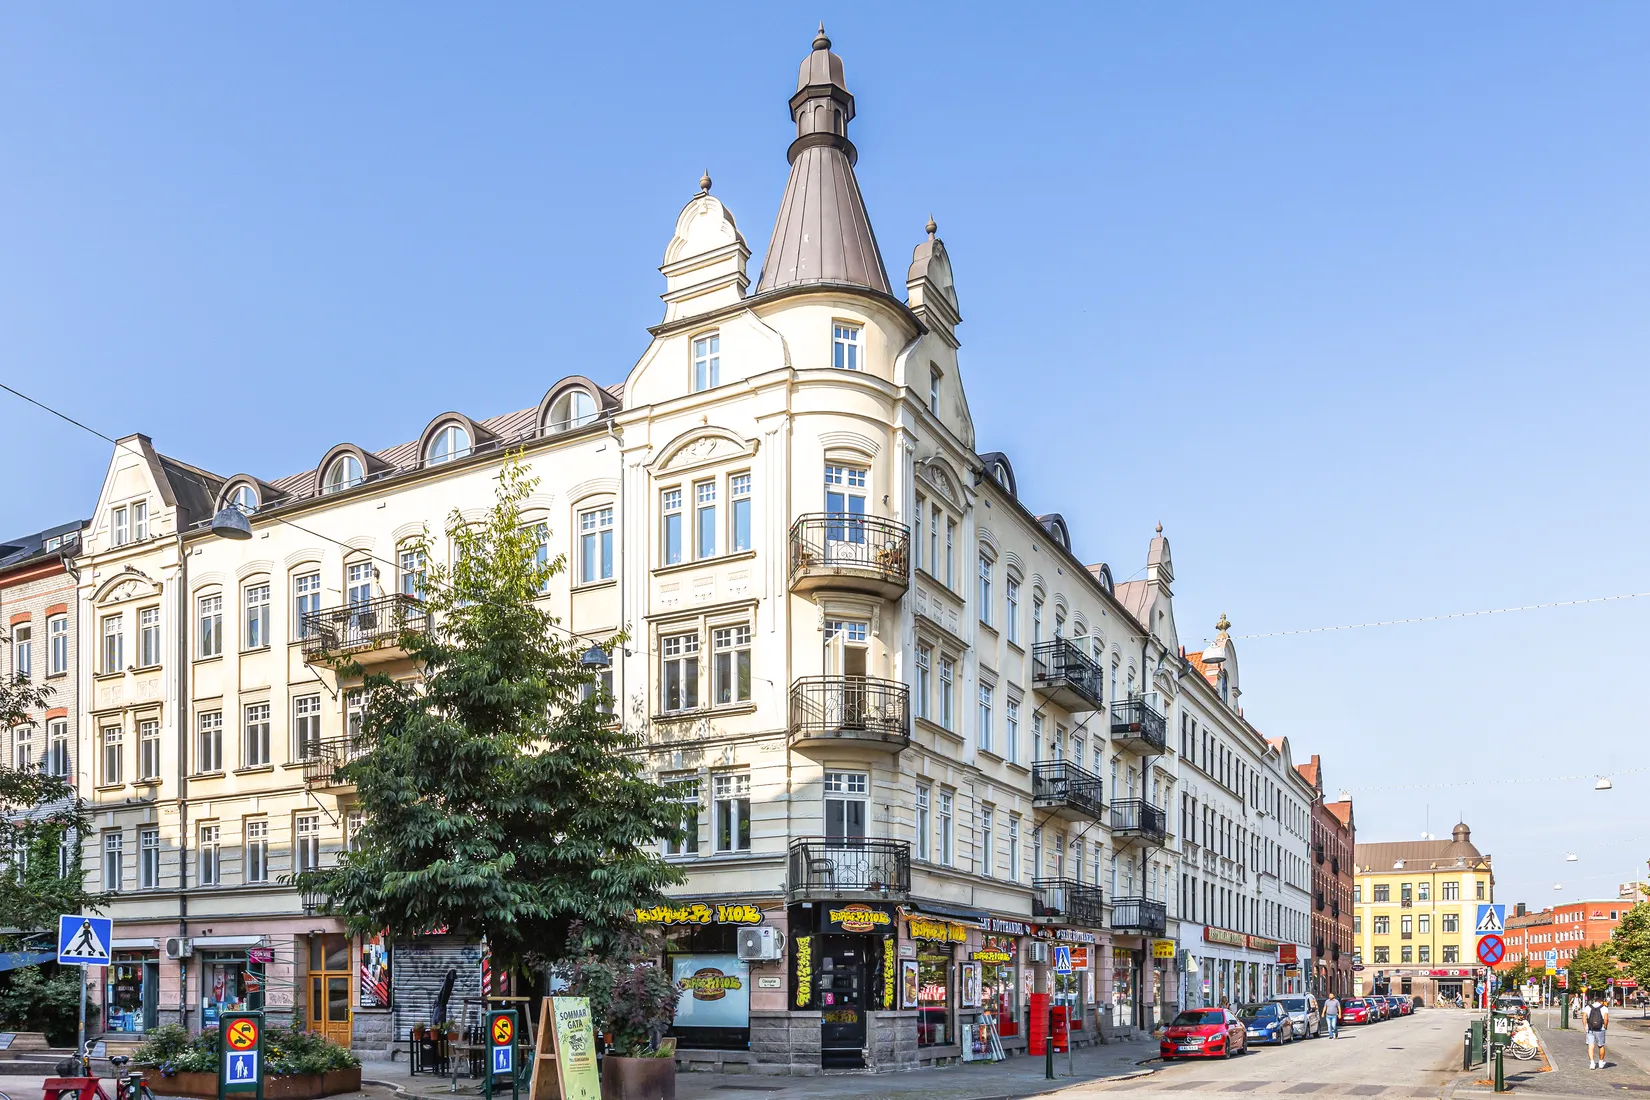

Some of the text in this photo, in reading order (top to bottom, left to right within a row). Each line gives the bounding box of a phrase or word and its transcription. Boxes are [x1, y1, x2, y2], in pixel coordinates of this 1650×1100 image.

[717, 904, 762, 924] MOB
[560, 1009, 587, 1020] SOMMAR
[567, 1020, 583, 1029] GATA
